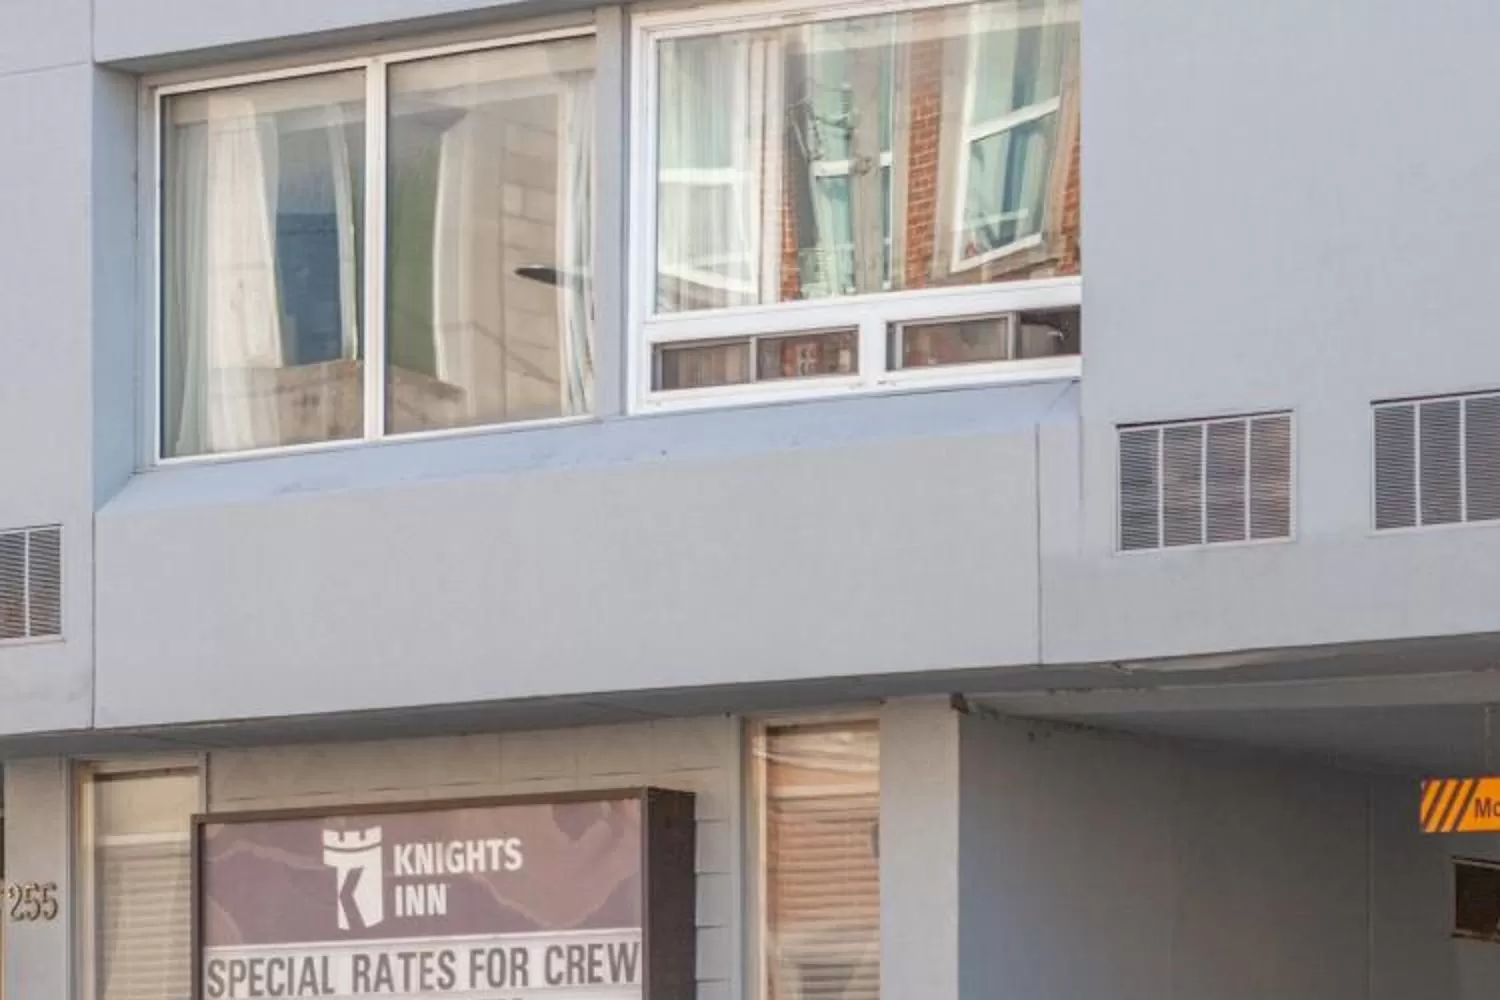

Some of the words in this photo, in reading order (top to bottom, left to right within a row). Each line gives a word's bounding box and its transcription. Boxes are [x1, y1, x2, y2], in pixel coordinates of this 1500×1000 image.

[394, 838, 523, 876] KNIGHTS
[8, 881, 59, 921] 255
[394, 882, 448, 917] INN
[207, 954, 335, 999] SPECIAL
[352, 949, 456, 993] RATES
[469, 946, 529, 990] FOR
[544, 941, 640, 986] CREW
